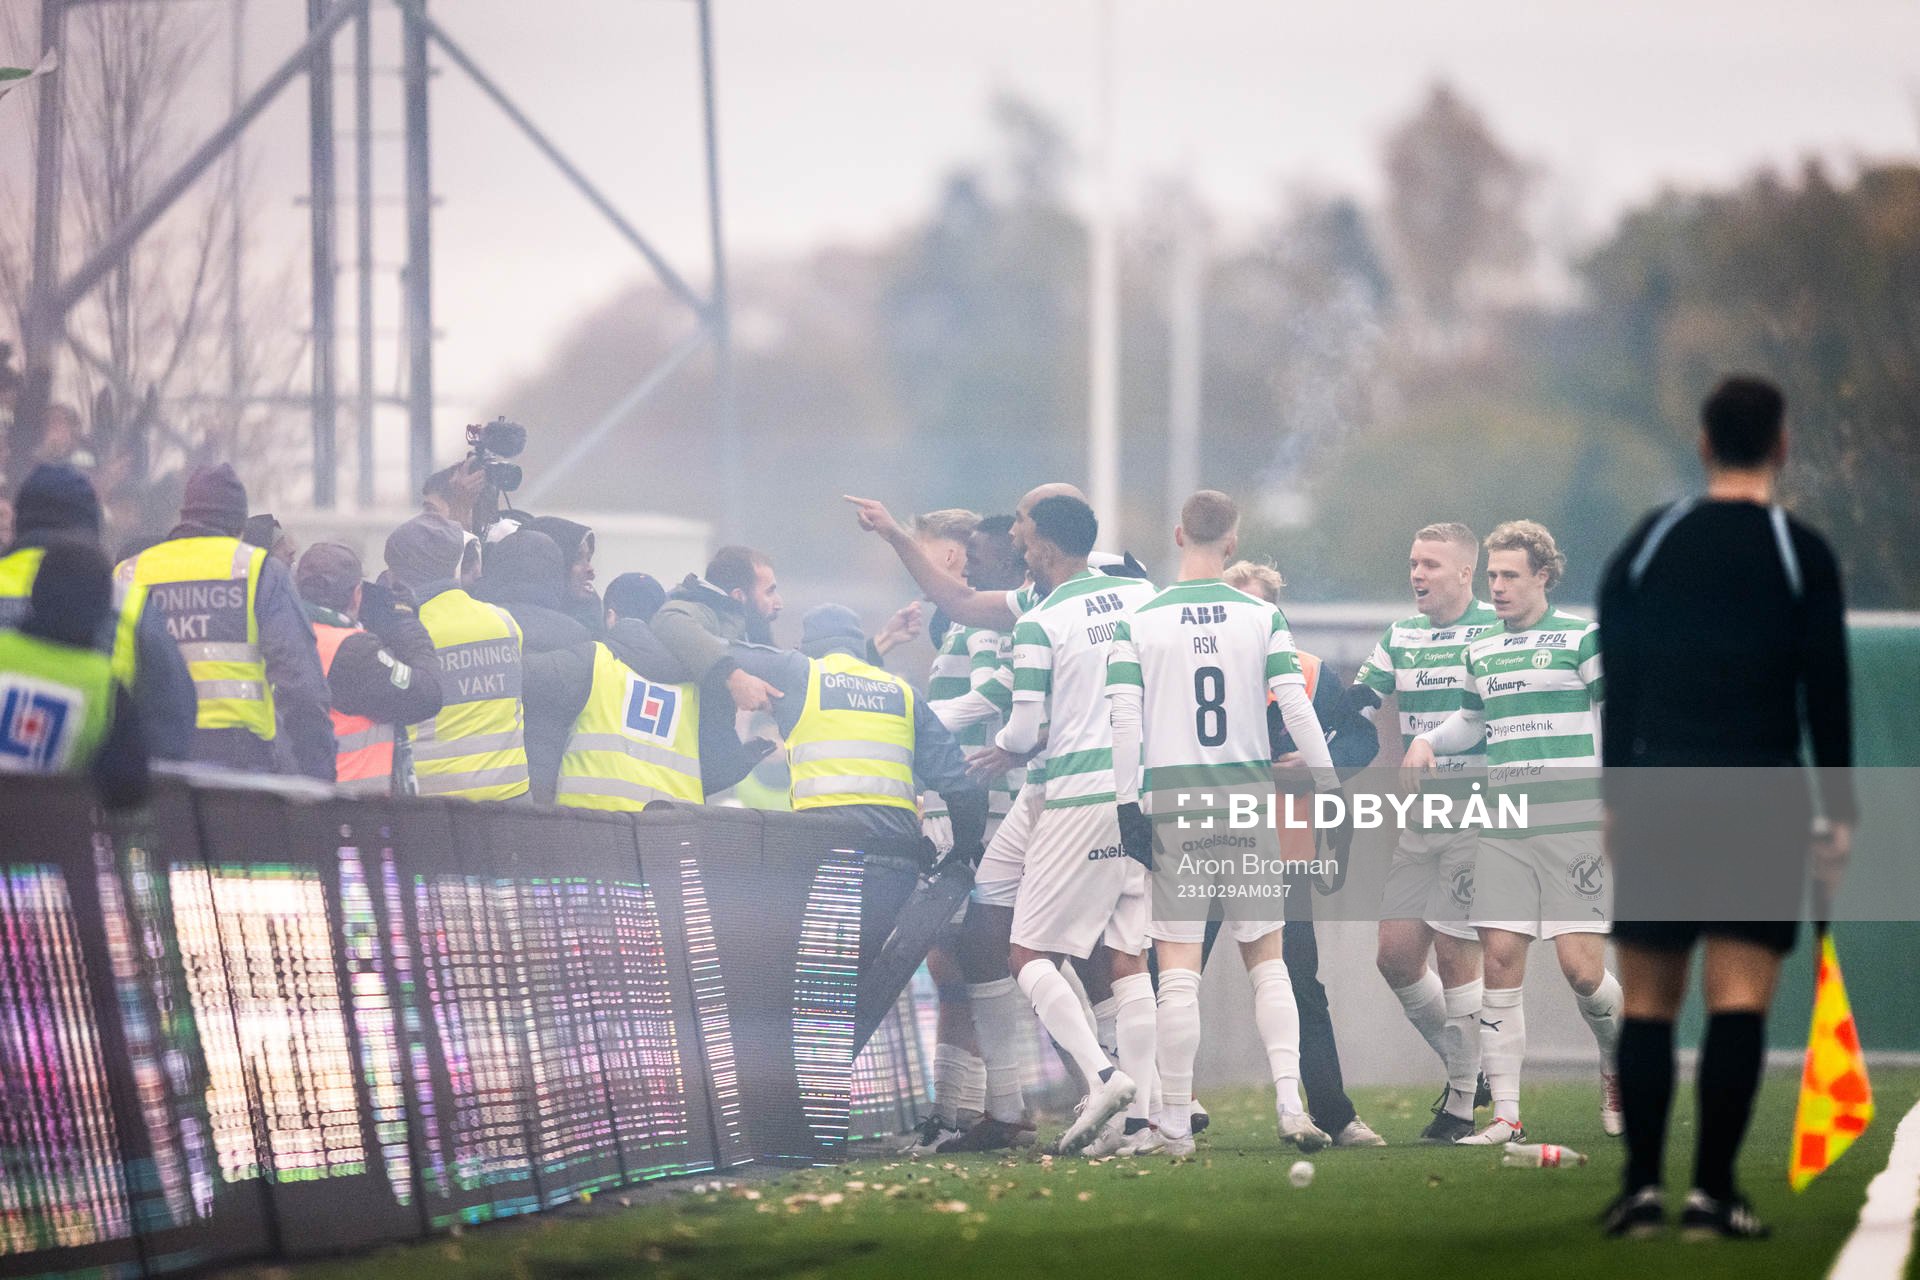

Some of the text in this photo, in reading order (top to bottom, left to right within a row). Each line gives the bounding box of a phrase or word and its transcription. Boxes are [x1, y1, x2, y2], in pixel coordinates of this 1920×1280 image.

[1085, 593, 1124, 616] ABB
[1180, 605, 1227, 625] ABB
[1193, 636, 1218, 654] ASK
[1537, 633, 1567, 643] SPOL
[458, 673, 505, 696] VAKT
[824, 674, 898, 694] ORDNINGS
[847, 693, 885, 711] VAKT
[1194, 666, 1227, 747] 8
[1494, 719, 1553, 736] Hygienteknik
[1182, 834, 1257, 851] axelssons
